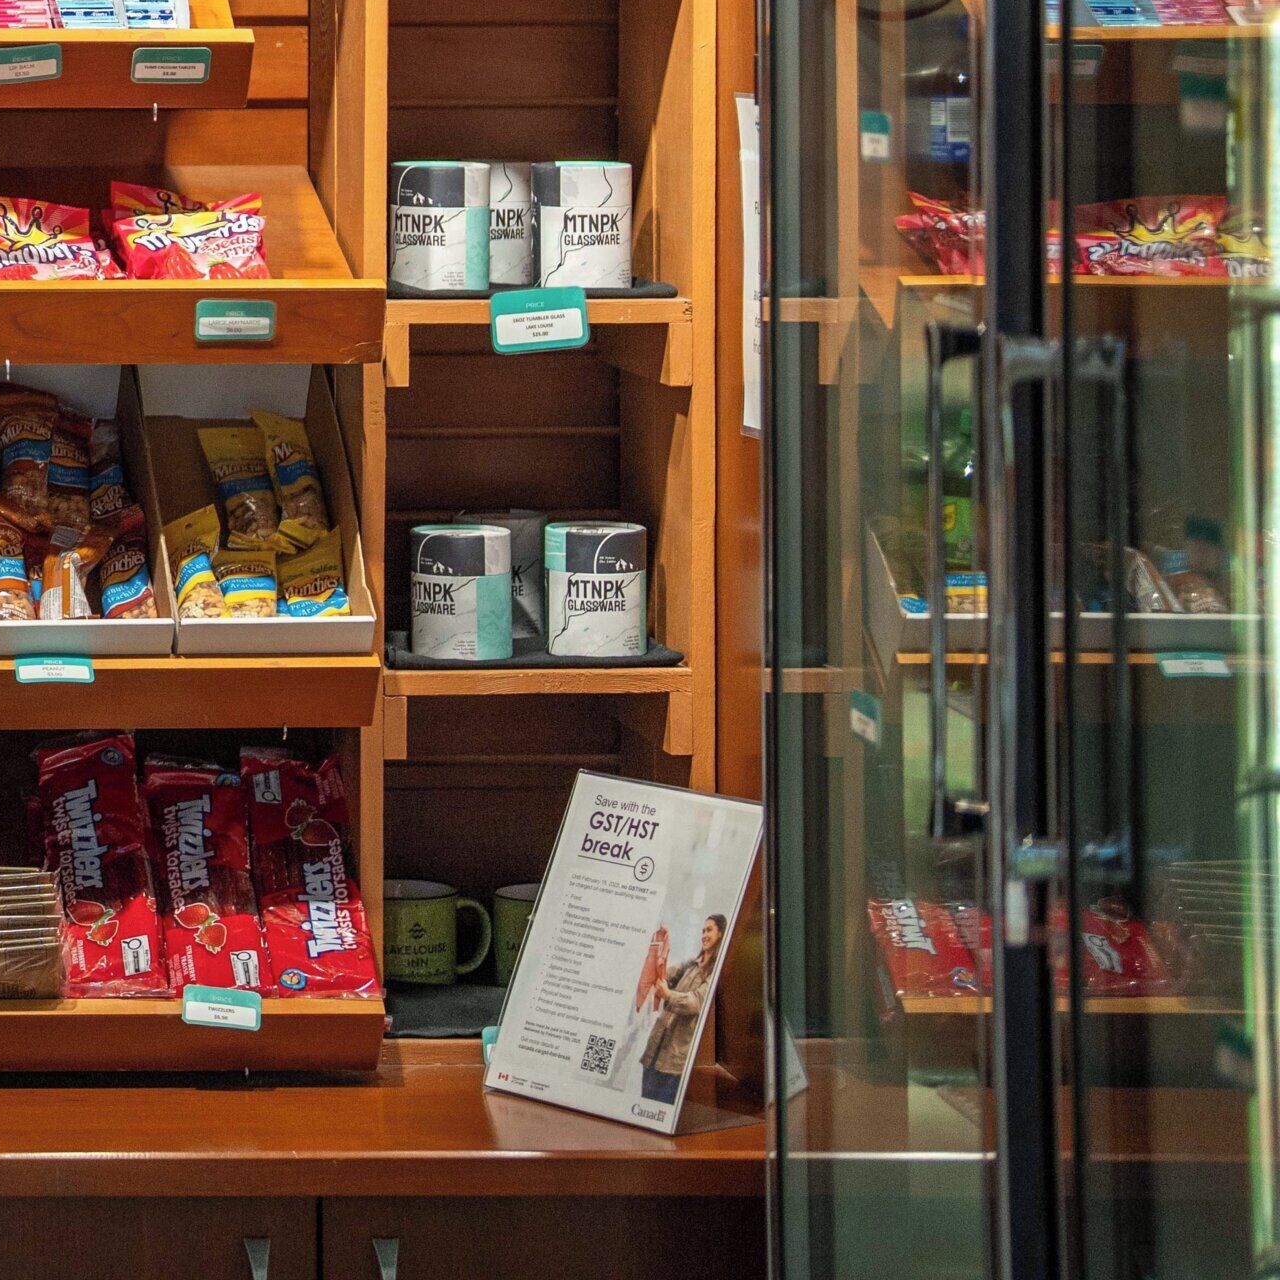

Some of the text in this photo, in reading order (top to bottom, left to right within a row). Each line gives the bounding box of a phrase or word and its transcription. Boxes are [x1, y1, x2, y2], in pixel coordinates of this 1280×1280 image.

[395, 213, 445, 234] MTNPK
[564, 213, 619, 232] MTNPK
[395, 234, 446, 246] GLASSWARE
[564, 234, 620, 245] GLASSWARE
[568, 579, 626, 599] MTNPK
[567, 600, 626, 612] GLASSWARE
[595, 794, 656, 816] Save with the
[590, 811, 659, 840] GST/HST
[51, 795, 77, 905] twists torsades
[176, 793, 215, 891] Twizzlers
[581, 833, 634, 860] break
[163, 805, 186, 914] twists torsades
[327, 838, 348, 904] torsades
[297, 861, 338, 959] Twizzlers
[630, 1103, 666, 1123] Canada
